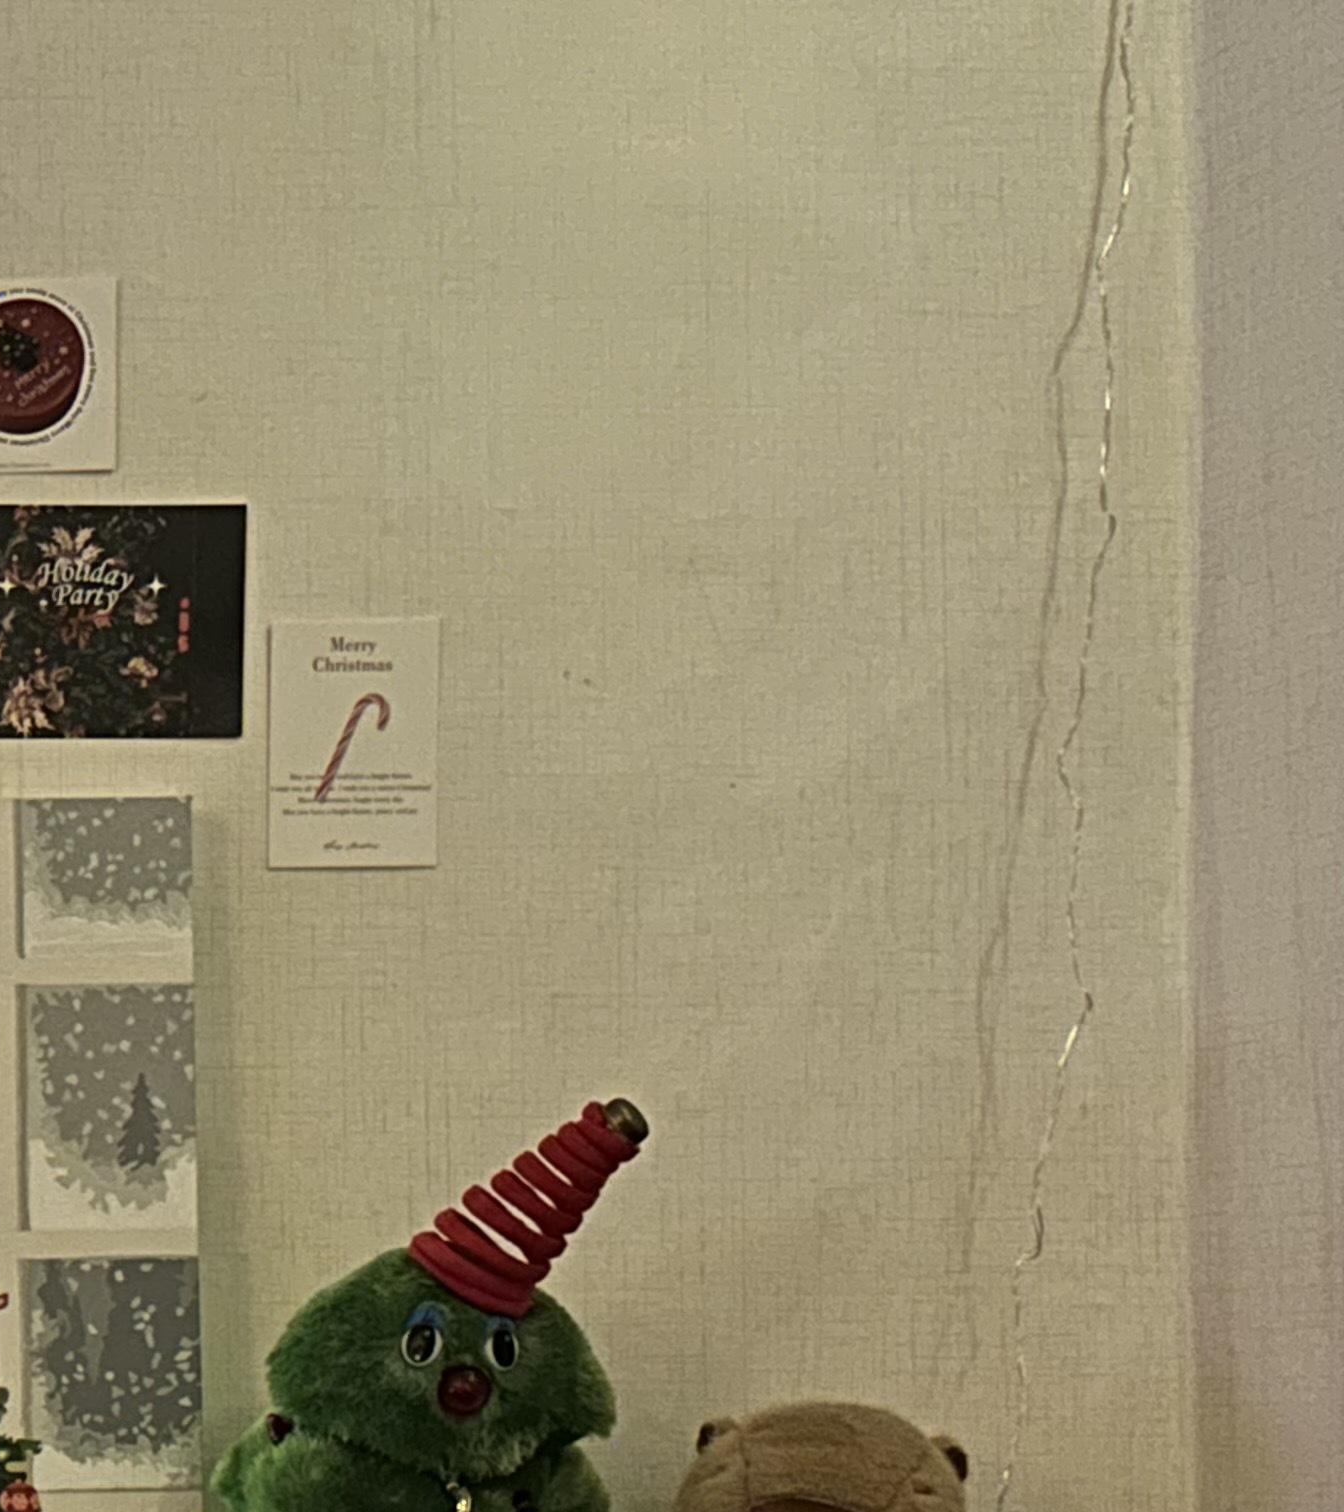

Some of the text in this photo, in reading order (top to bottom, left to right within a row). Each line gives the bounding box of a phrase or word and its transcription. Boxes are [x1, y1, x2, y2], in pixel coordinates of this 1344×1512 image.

[37, 557, 134, 593] Holiday
[52, 584, 120, 614] Party
[330, 636, 377, 656] Merry
[312, 656, 393, 673] Christmas
